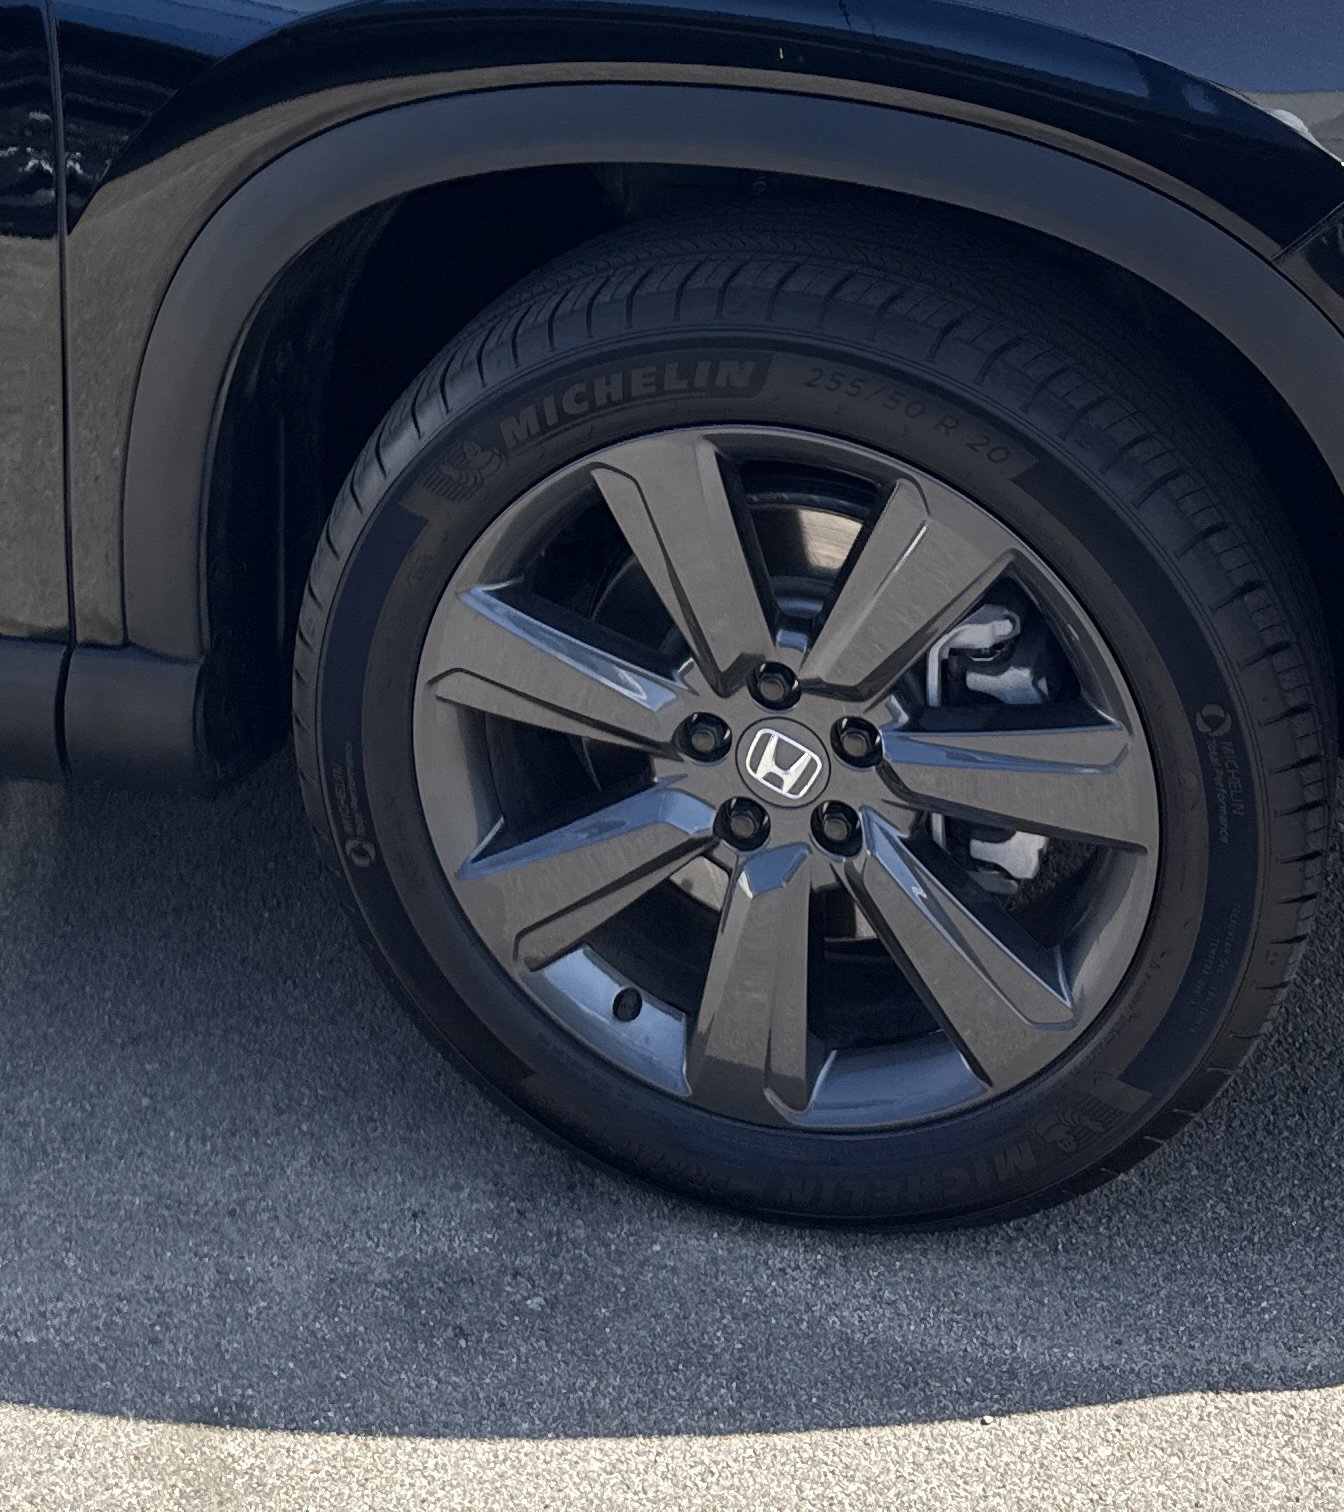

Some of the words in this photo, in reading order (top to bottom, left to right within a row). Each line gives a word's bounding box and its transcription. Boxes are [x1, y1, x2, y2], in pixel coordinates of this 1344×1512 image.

[499, 360, 756, 450] MICHELIN
[802, 367, 927, 419] 255/50
[932, 414, 961, 437] R
[965, 433, 1013, 464] 20
[1219, 739, 1245, 817] MICHELIN
